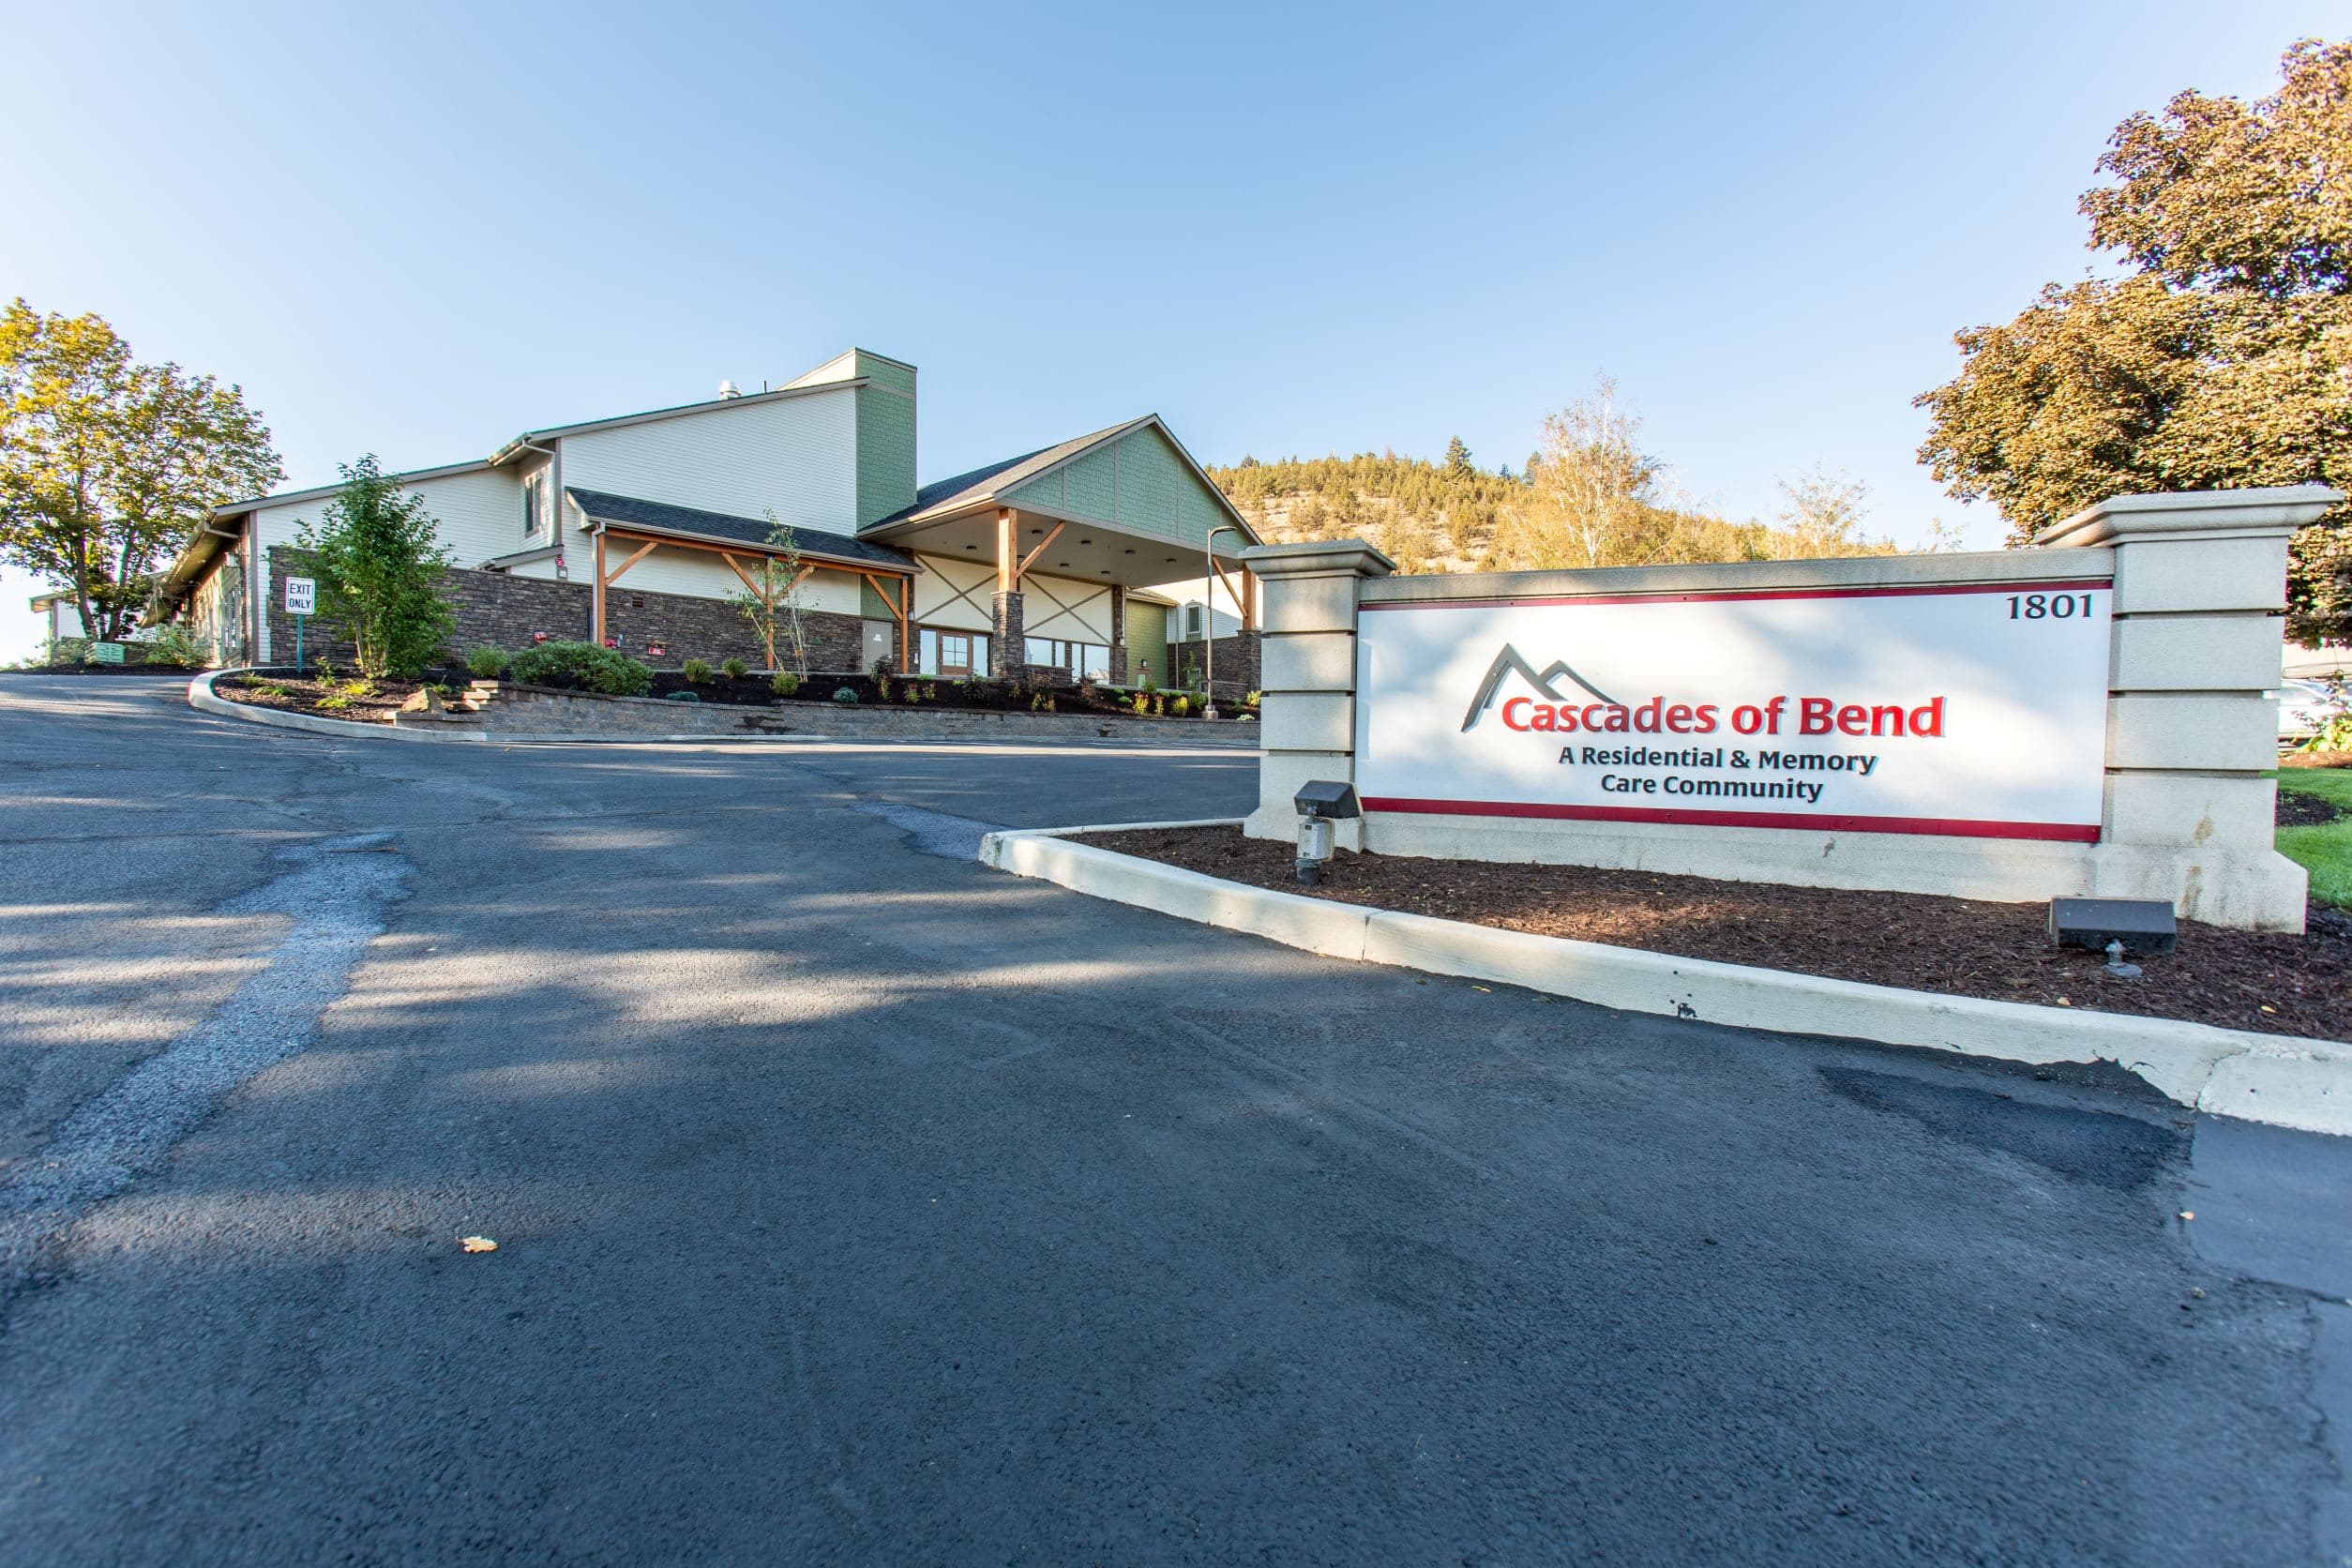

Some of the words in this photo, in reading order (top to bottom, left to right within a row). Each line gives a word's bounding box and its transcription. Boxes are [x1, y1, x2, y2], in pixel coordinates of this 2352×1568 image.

[289, 597, 311, 609] ONLY
[290, 582, 311, 596] EXIT
[2006, 593, 2092, 619] 1801
[1501, 695, 1718, 734] Cascades
[1731, 695, 1787, 735] of
[1799, 696, 1945, 738] Bend
[1558, 746, 1575, 765] A
[1581, 746, 1723, 768] Residential
[1729, 749, 1751, 769] &
[1758, 750, 1877, 776] Memory
[1601, 774, 1657, 793] Care
[1663, 776, 1824, 804] Community
